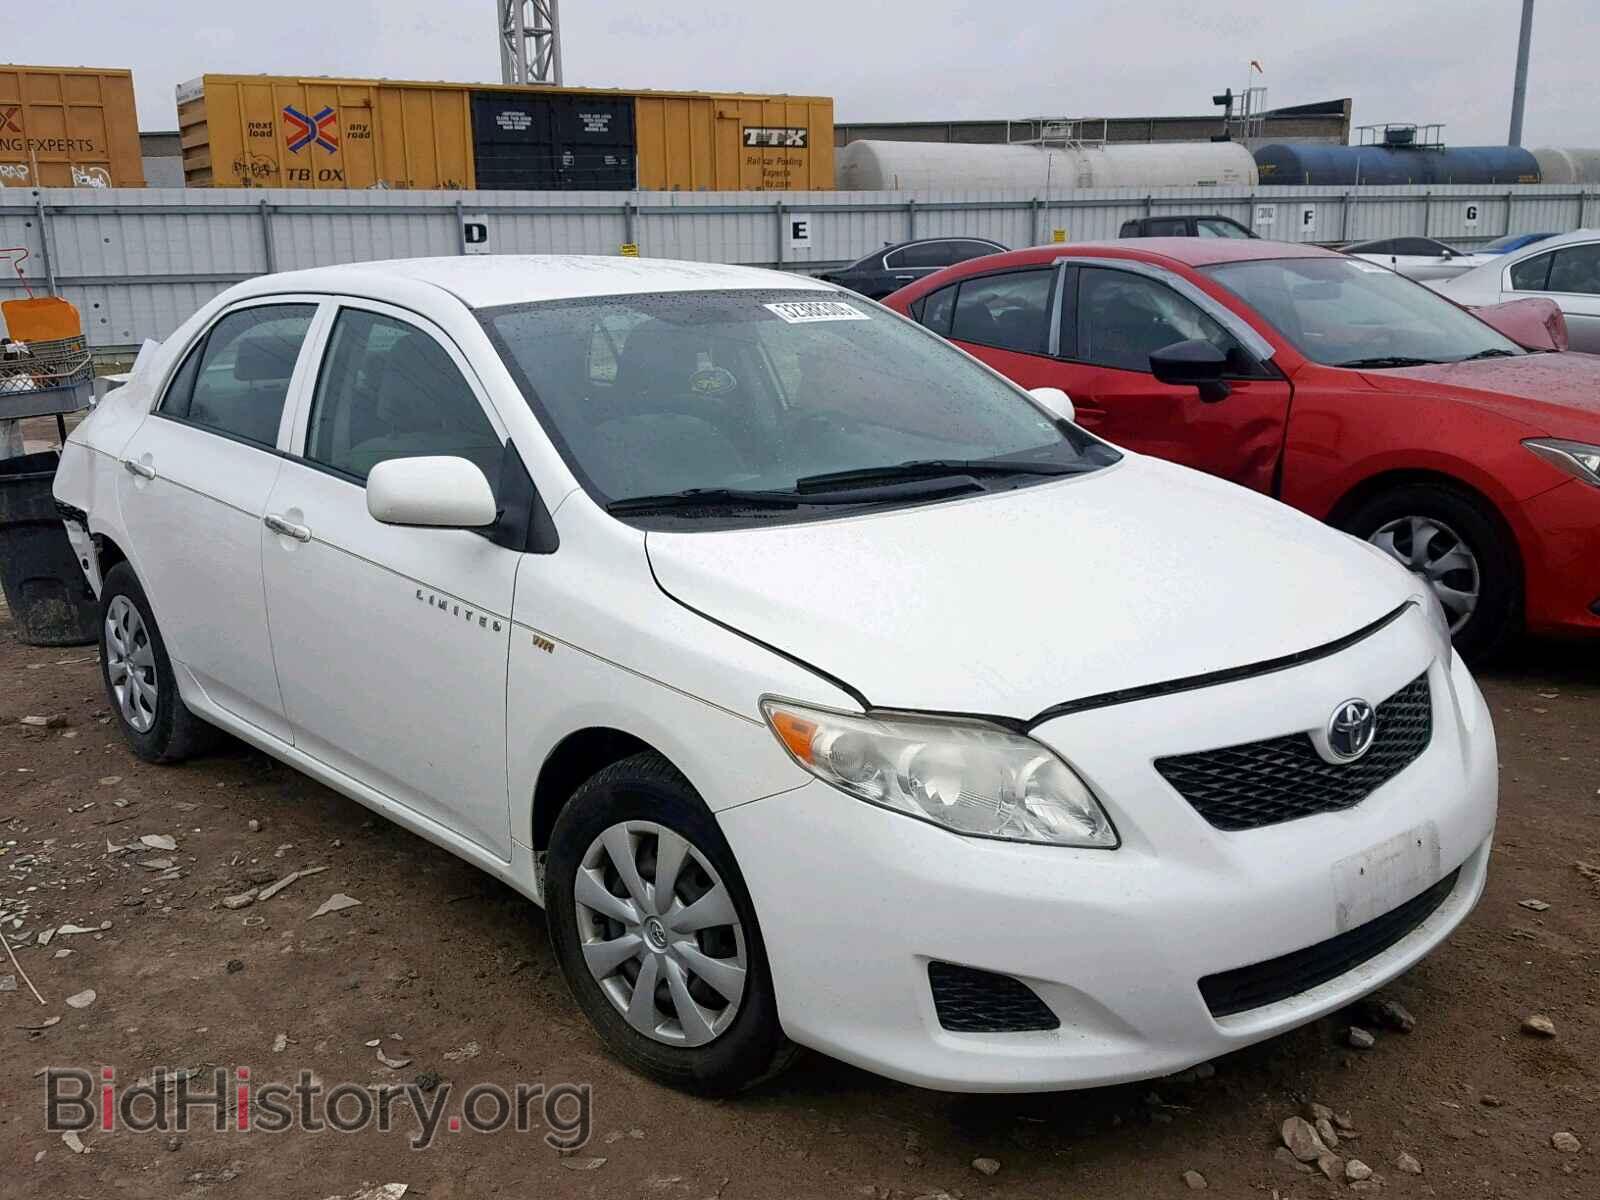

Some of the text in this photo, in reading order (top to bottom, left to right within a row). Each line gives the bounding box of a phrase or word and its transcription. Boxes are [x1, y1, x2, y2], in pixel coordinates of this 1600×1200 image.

[249, 129, 272, 138] load
[350, 123, 367, 132] any
[347, 131, 370, 139] road
[744, 128, 806, 146] TTX
[28, 139, 94, 152] EXPERTS
[1304, 210, 1313, 225] F
[1466, 206, 1477, 220] G
[464, 223, 487, 243] D
[792, 222, 808, 239] E
[415, 588, 502, 632] LIMITED
